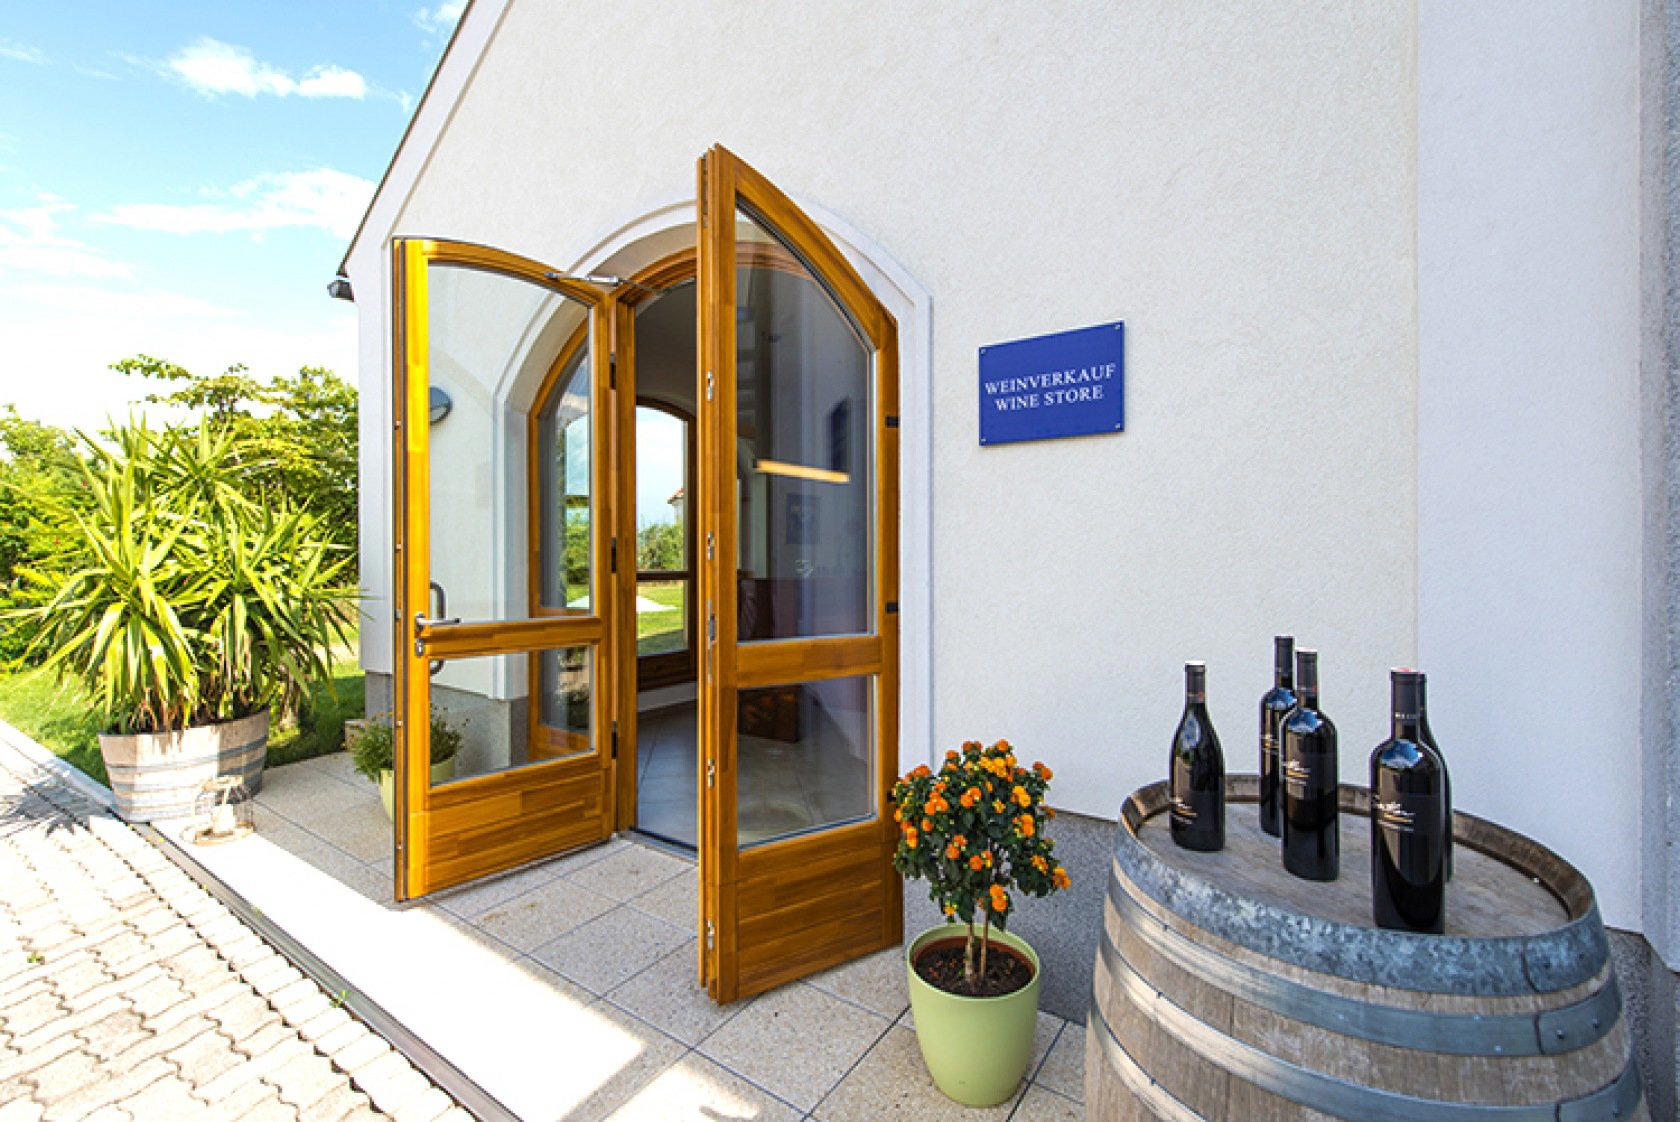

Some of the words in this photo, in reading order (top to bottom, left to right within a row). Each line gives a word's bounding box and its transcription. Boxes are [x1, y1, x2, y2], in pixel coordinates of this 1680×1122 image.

[985, 363, 1116, 395] WEINVERKAUF
[995, 393, 1040, 411] WINE
[1044, 384, 1103, 406] STORE
